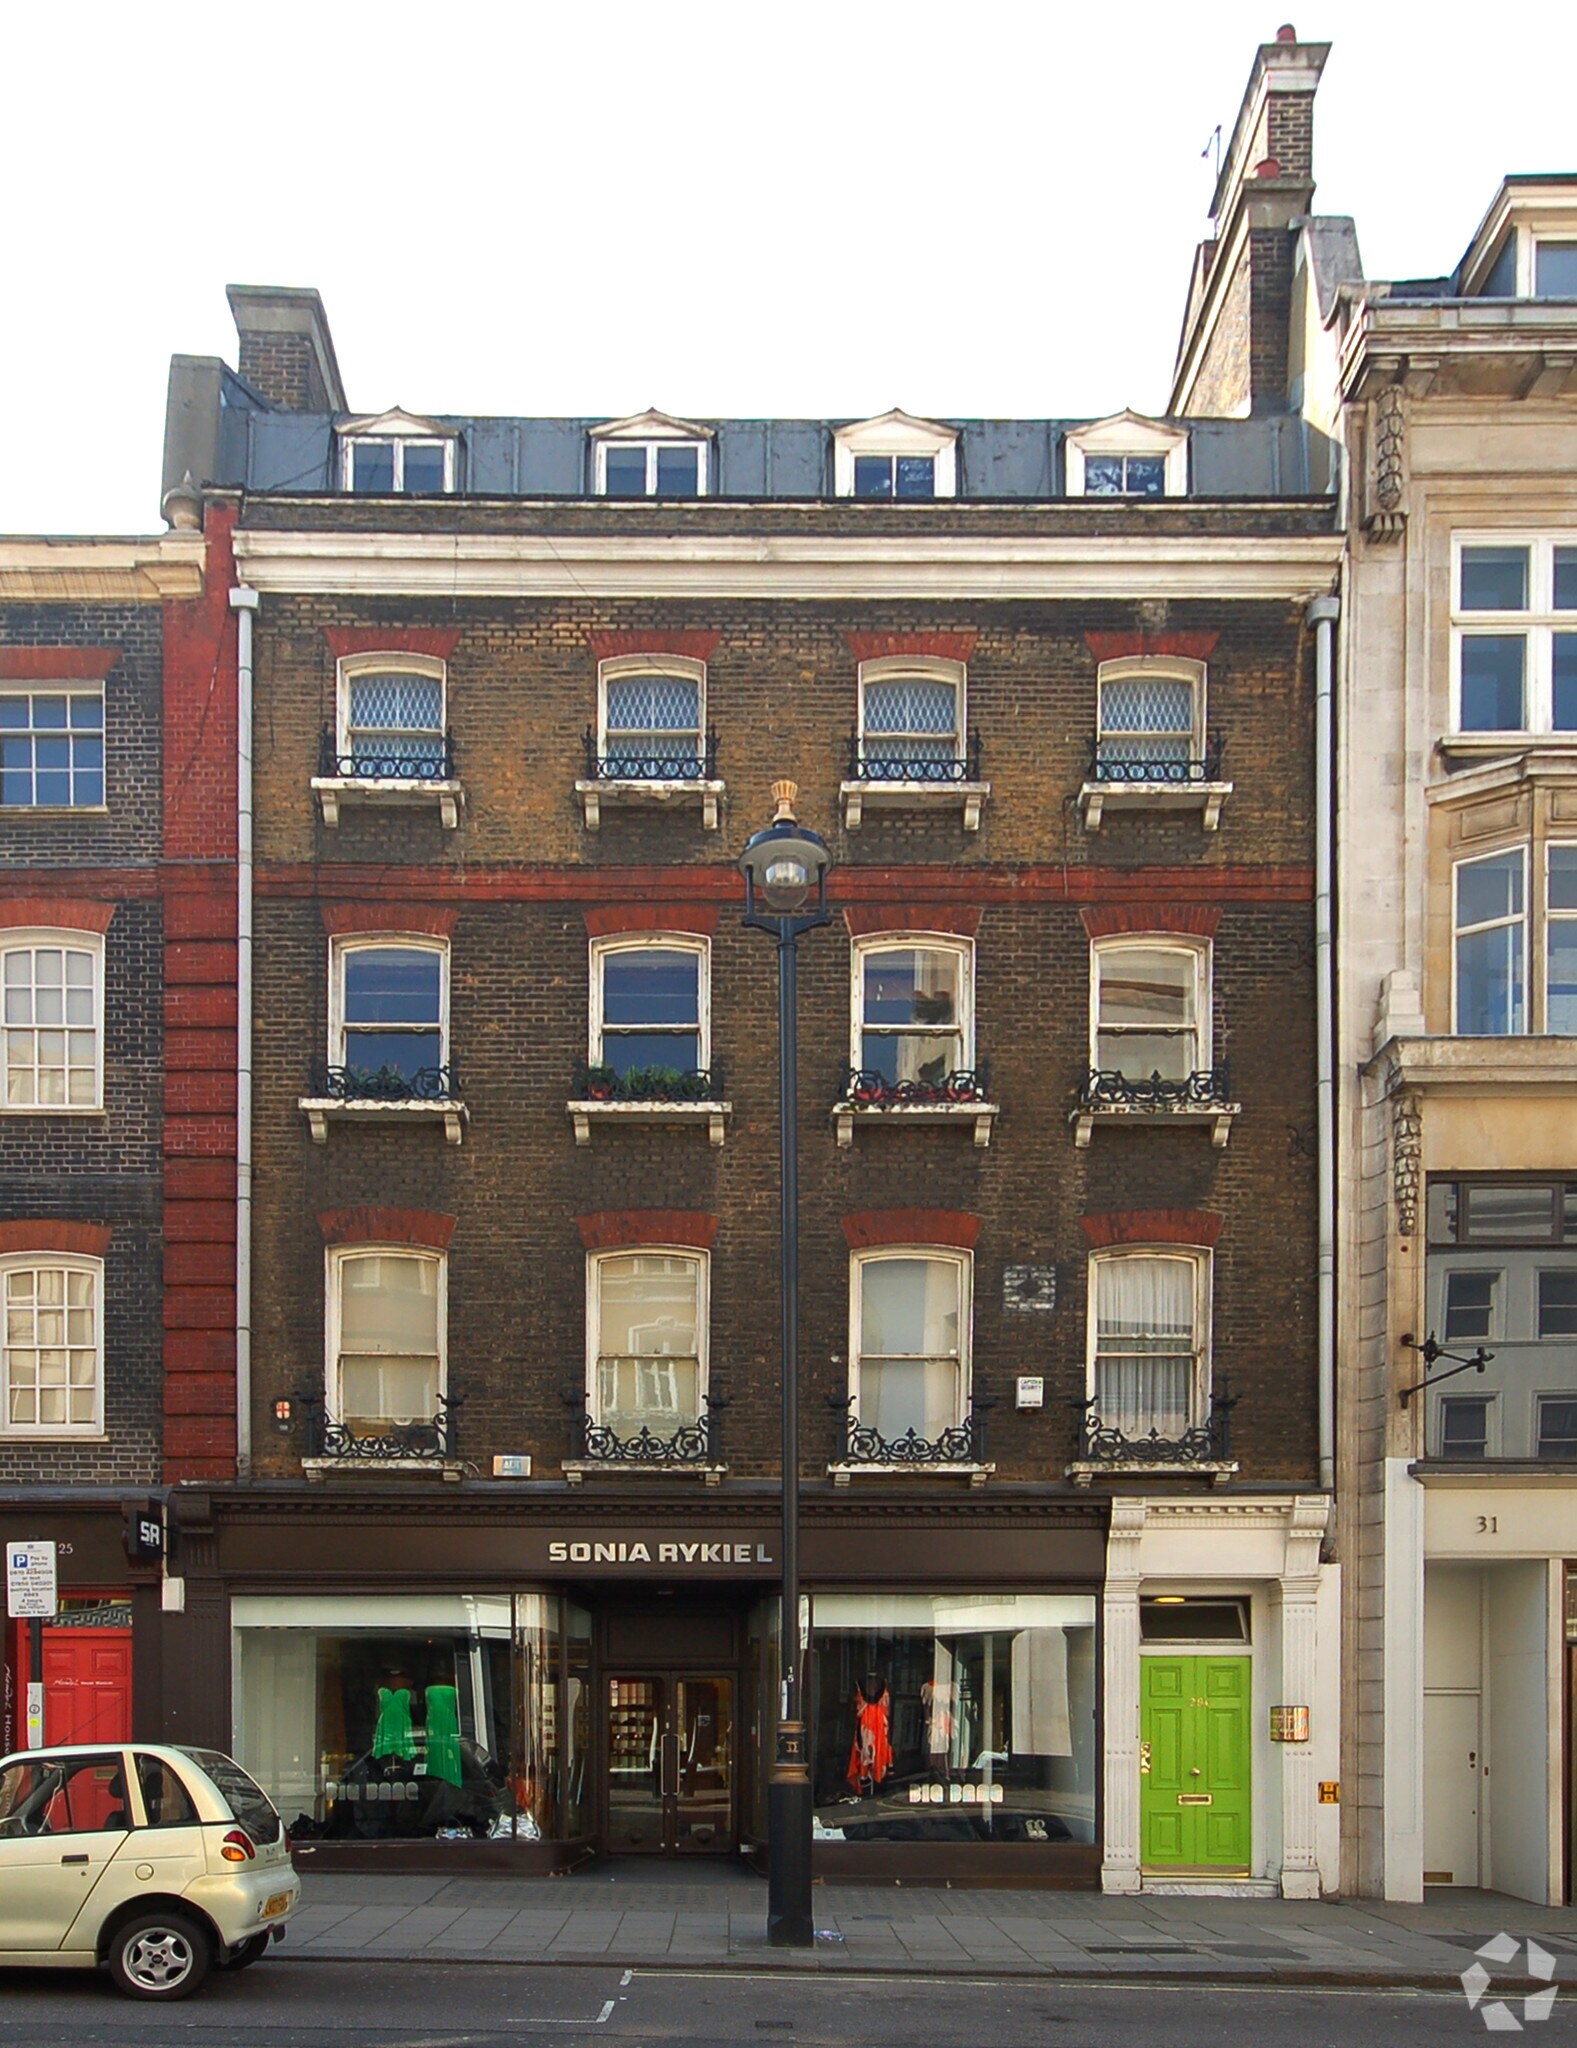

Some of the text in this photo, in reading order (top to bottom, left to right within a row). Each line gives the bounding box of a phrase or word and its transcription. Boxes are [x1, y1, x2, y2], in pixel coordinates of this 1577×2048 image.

[140, 1520, 160, 1546] SR
[1475, 1515, 1497, 1534] 31
[58, 1543, 74, 1555] 25
[549, 1542, 773, 1562] SONIA RYKIEL
[1321, 1783, 1337, 1802] H
